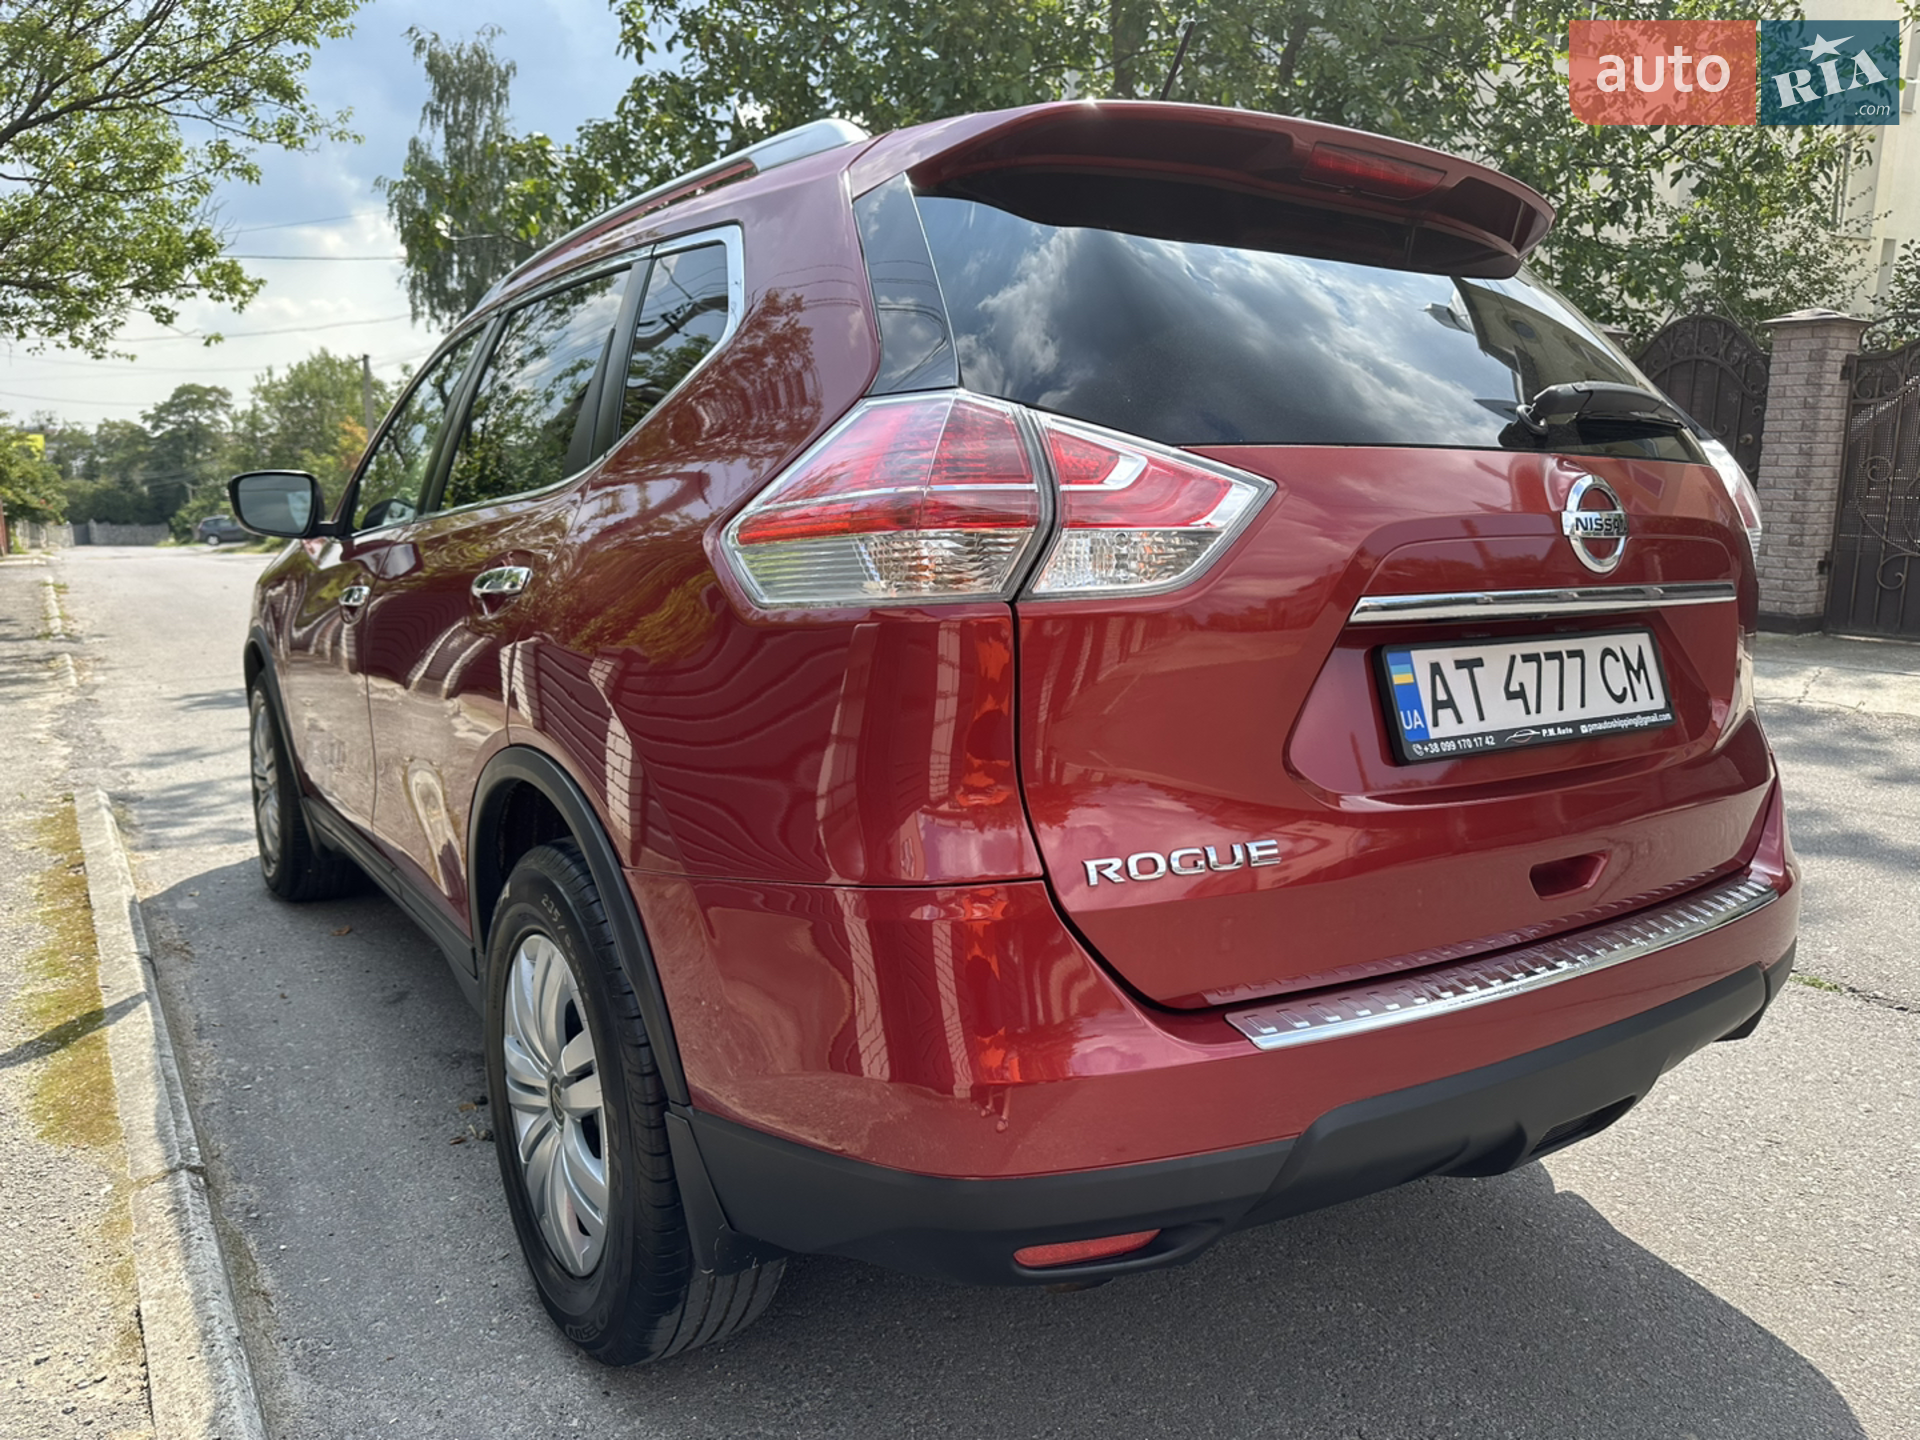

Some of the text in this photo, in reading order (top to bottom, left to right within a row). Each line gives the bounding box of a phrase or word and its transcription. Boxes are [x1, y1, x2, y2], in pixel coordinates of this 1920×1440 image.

[1428, 644, 1655, 728] AT 4777 CM
[1400, 709, 1425, 731] UA
[1423, 735, 1496, 754] +38 099 170 17 42
[1082, 839, 1282, 886] ROGUE
